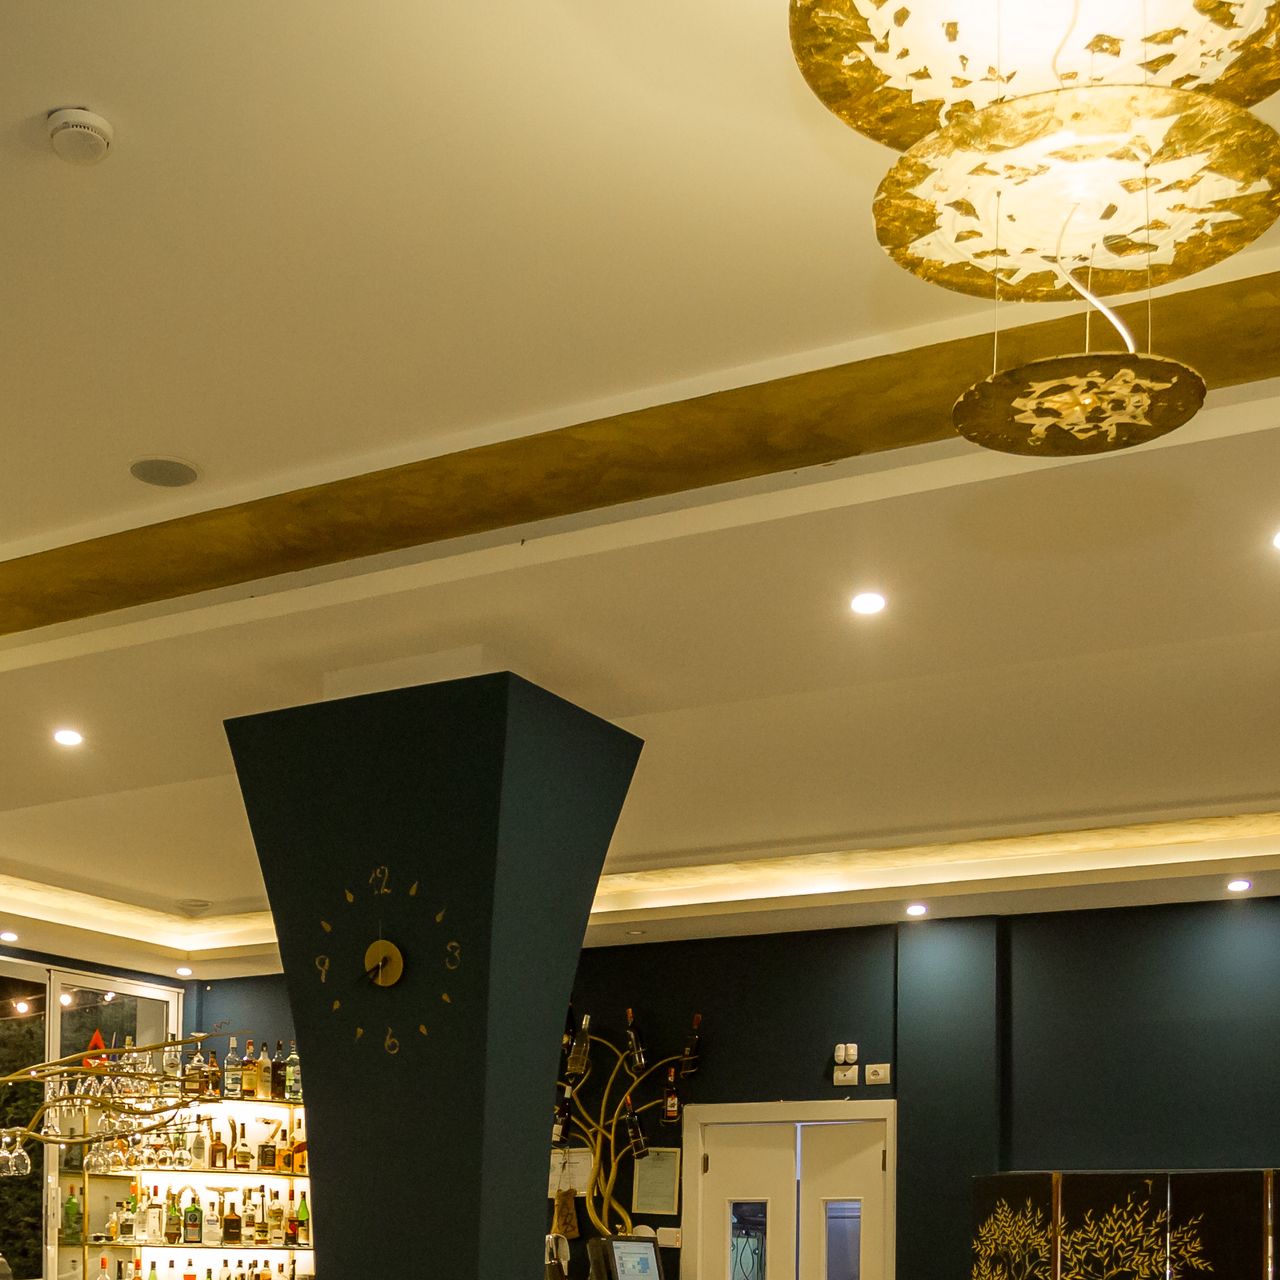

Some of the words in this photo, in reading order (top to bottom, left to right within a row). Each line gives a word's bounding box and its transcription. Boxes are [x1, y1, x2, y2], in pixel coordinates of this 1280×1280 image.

[369, 865, 392, 895] 12
[315, 955, 331, 983] 9
[445, 941, 462, 970] 3
[384, 1026, 400, 1055] 6
